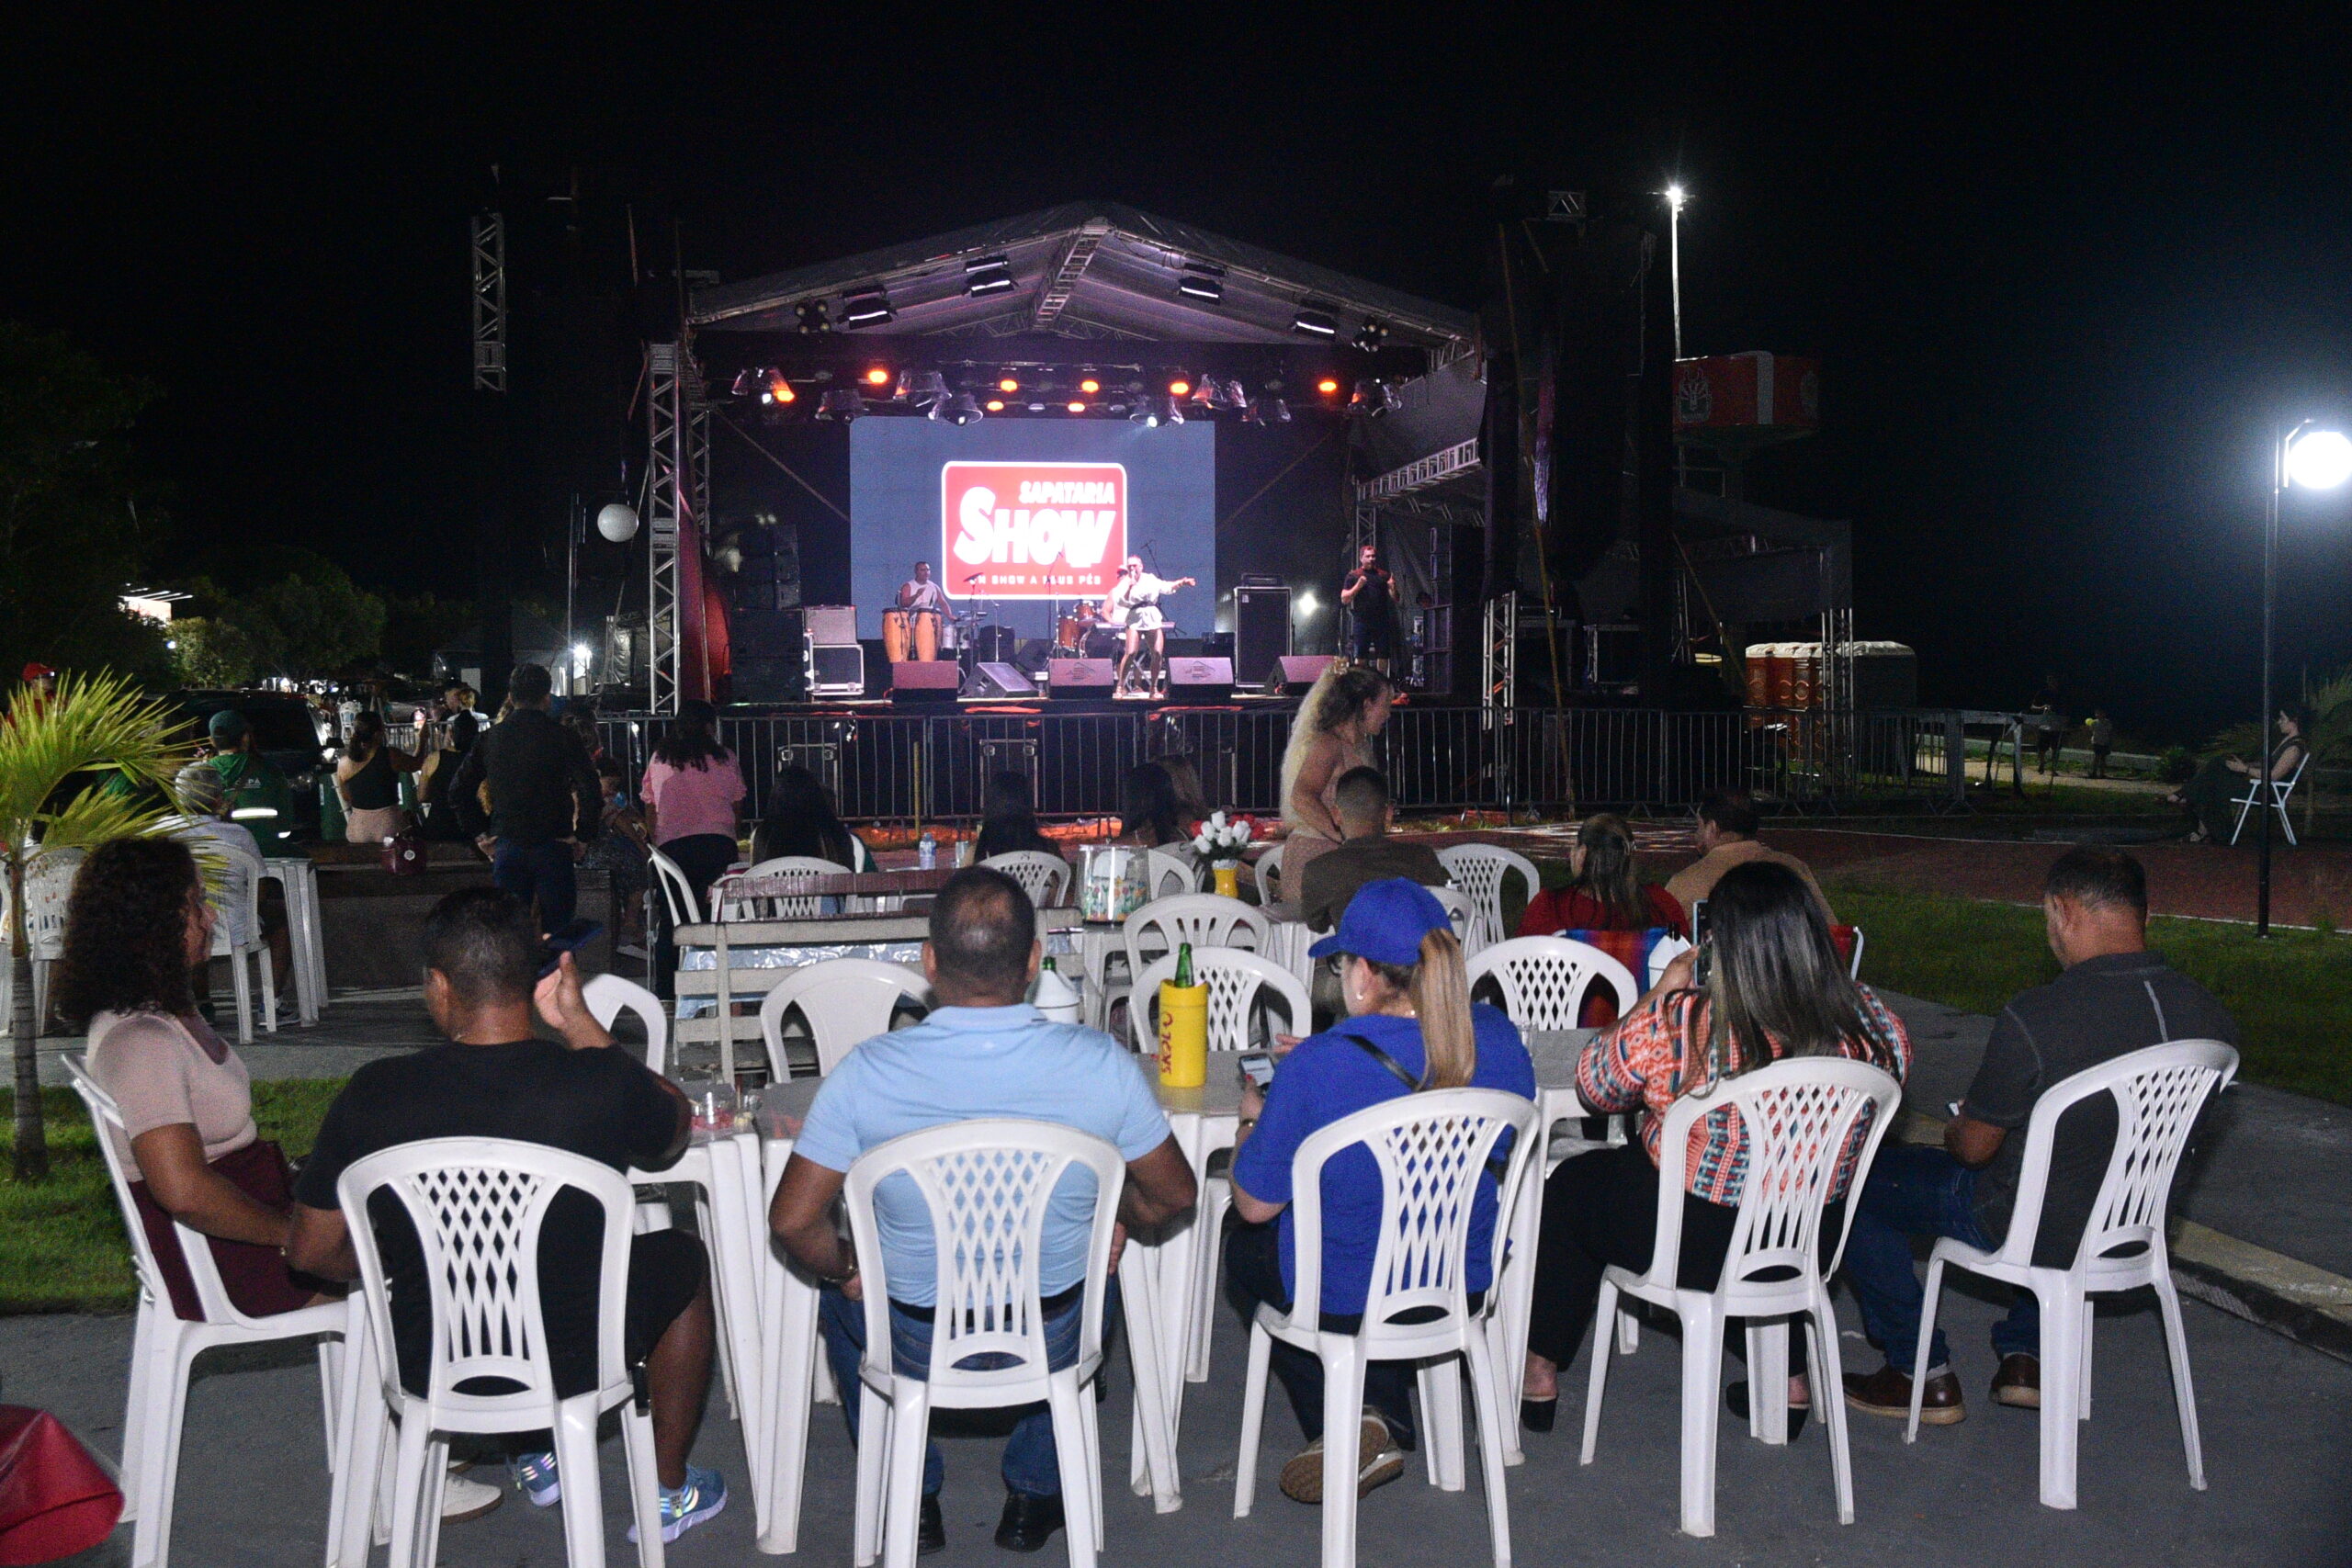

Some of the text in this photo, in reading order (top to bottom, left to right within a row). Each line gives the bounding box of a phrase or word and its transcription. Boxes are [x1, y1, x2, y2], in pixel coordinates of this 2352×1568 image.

[1019, 480, 1115, 504] SAPATARIA
[953, 486, 1117, 568] SHOW
[991, 575, 1025, 585] SHOW
[1029, 575, 1038, 585] A
